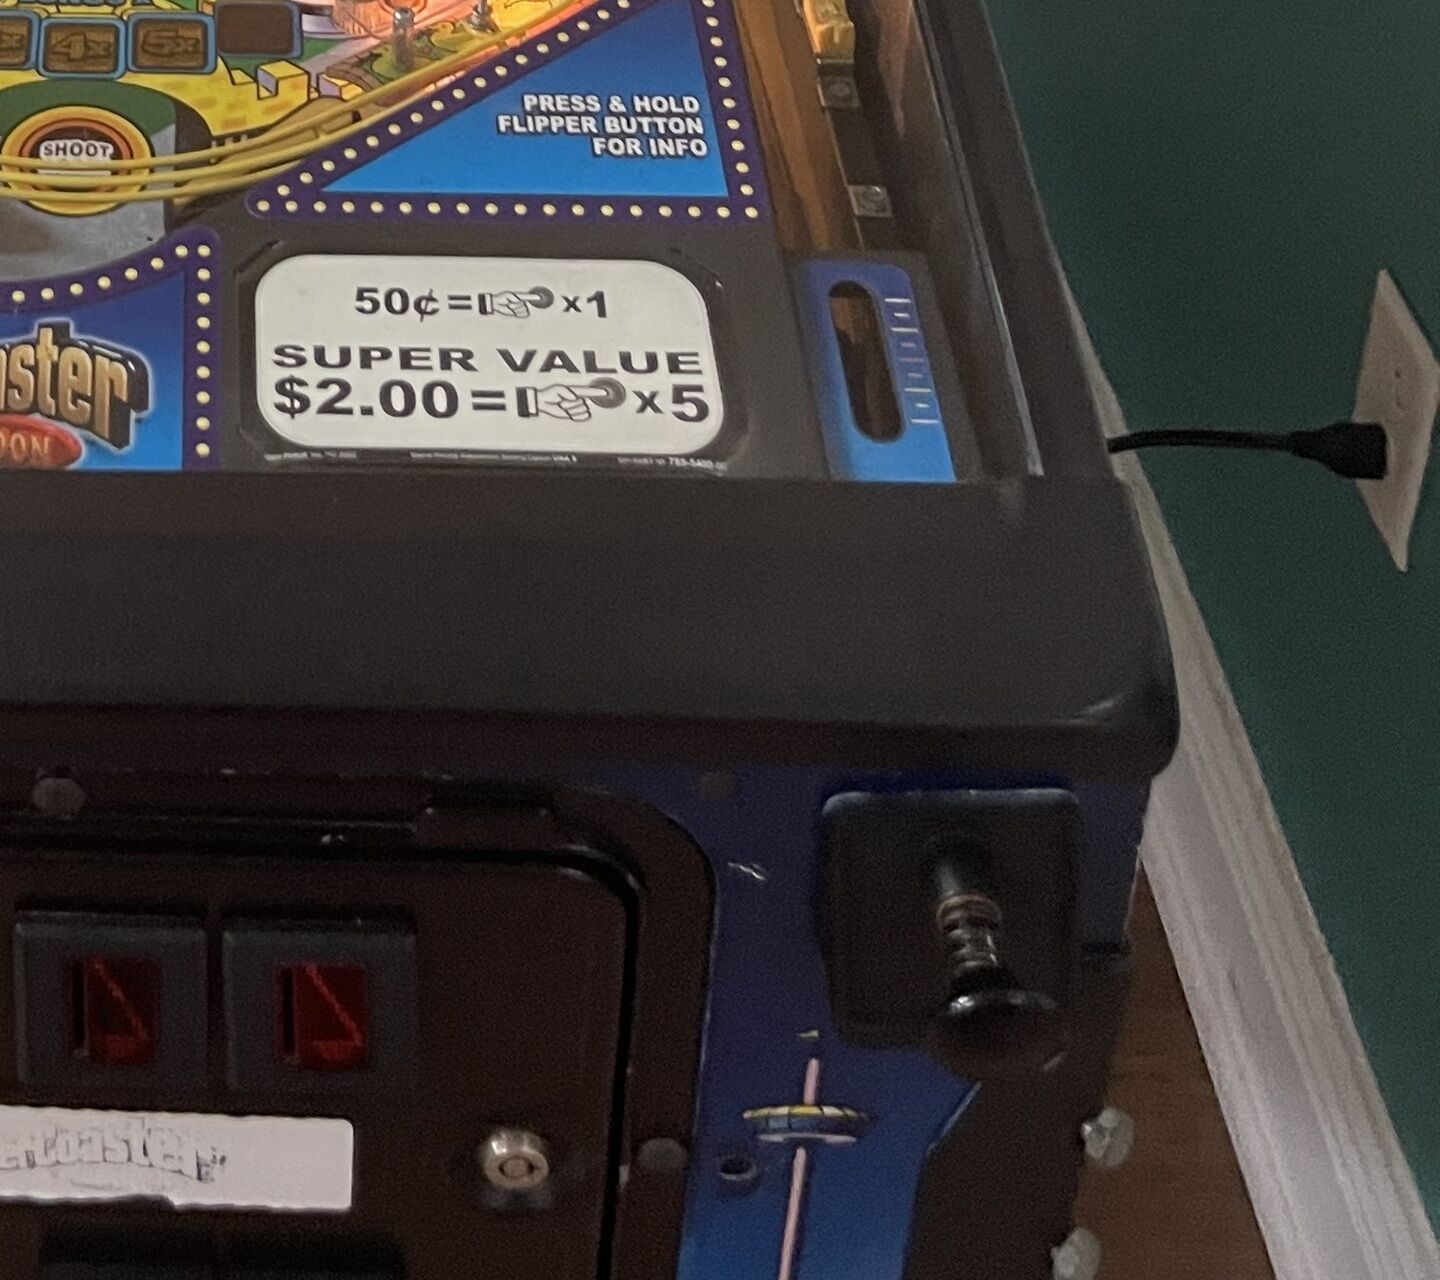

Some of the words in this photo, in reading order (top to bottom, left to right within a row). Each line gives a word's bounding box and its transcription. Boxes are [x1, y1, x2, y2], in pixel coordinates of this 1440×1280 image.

[49, 32, 113, 62] 4x
[522, 94, 601, 114] PRESS
[608, 95, 628, 113] &
[634, 95, 701, 115] HOLD
[497, 115, 598, 135] FLIPPER
[605, 116, 705, 136] BUTTON
[44, 142, 109, 157] SHOOT
[592, 137, 643, 157] FOR
[650, 137, 709, 158] INFO
[272, 344, 478, 374] SUPER
[496, 348, 703, 376] VALUE
